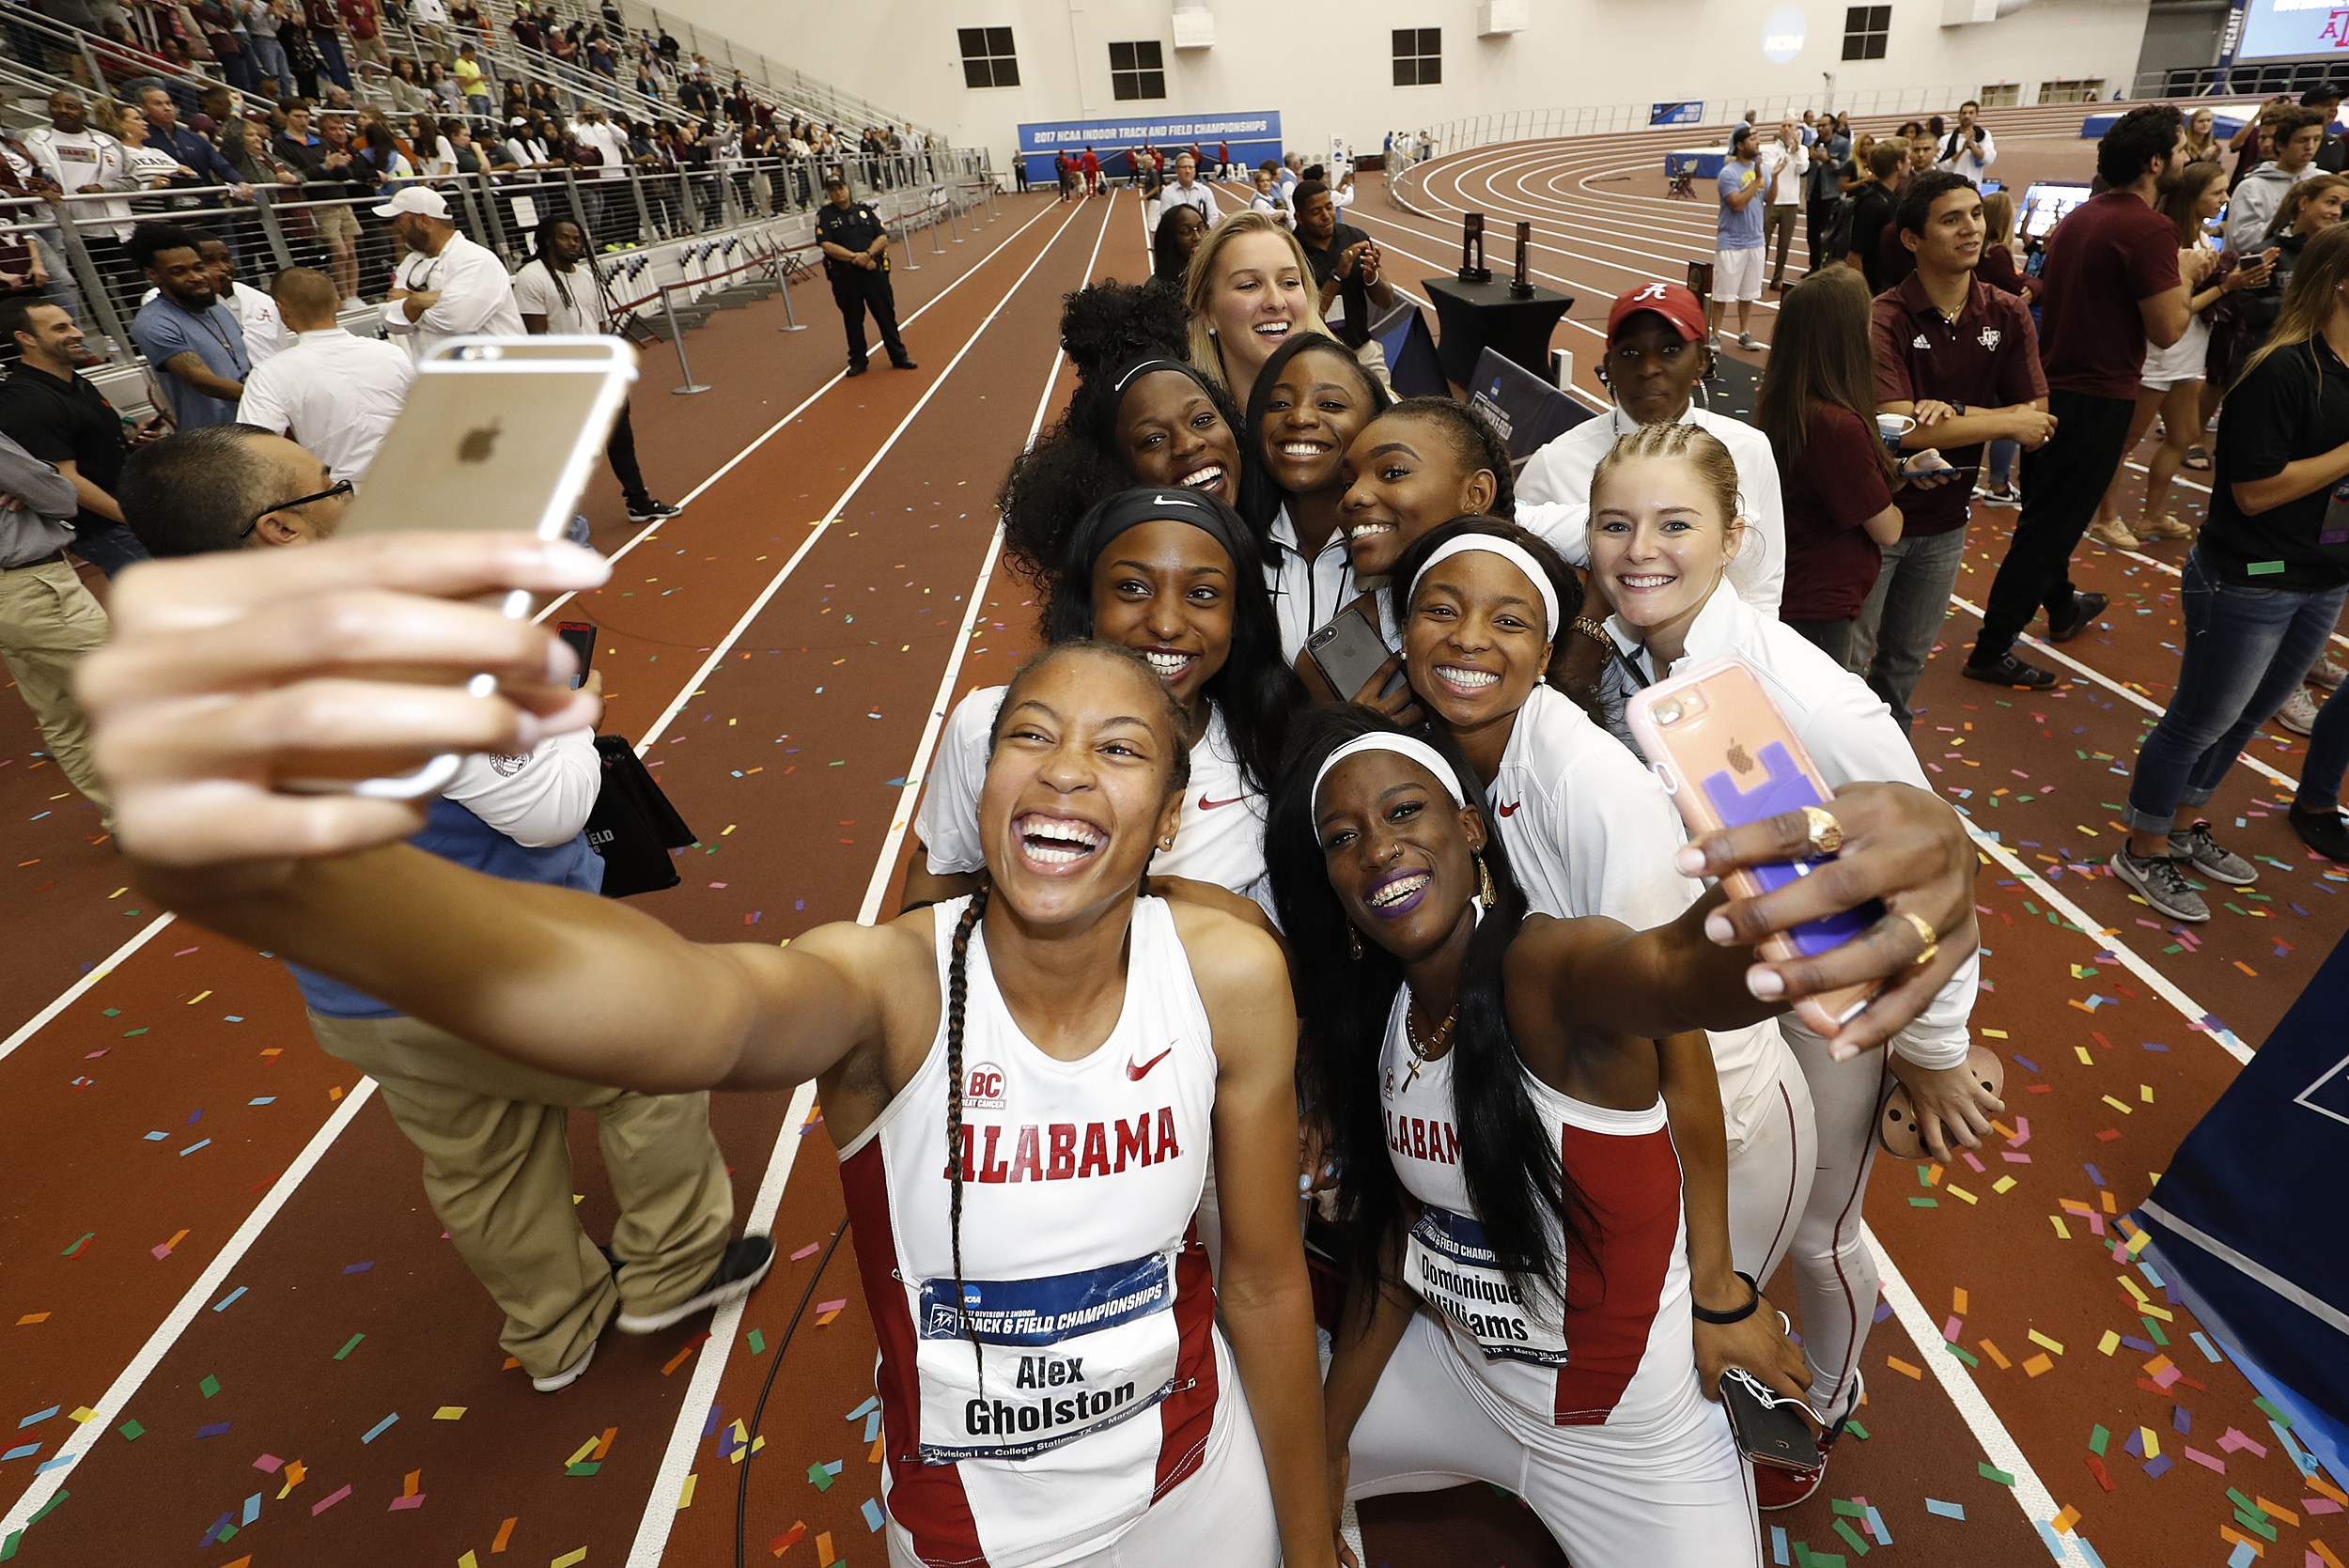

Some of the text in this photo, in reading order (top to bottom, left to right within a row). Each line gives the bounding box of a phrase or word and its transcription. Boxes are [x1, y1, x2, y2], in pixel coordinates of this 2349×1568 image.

[1034, 120, 1268, 144] 2017 NCAA INDOOR TRACK AND FIELD CHAMPIONSHIPS
[970, 1071, 1002, 1098] BC
[977, 1099, 1004, 1109] CANCER
[1439, 1235, 1459, 1255] FIELD
[1422, 1253, 1523, 1306] Domonique
[974, 1310, 1004, 1318] DIVISION
[1009, 1309, 1036, 1318] INDOOR
[1003, 1318, 1014, 1334] &
[1014, 1316, 1055, 1334] FIELD
[1056, 1282, 1163, 1330] CHAMPIONSHIPS
[1513, 1347, 1538, 1358] March
[1016, 1356, 1085, 1389] Alex
[965, 1381, 1135, 1436] Gholston
[933, 1448, 972, 1458] Division
[994, 1446, 1034, 1457] College
[1079, 1426, 1092, 1436] TX
